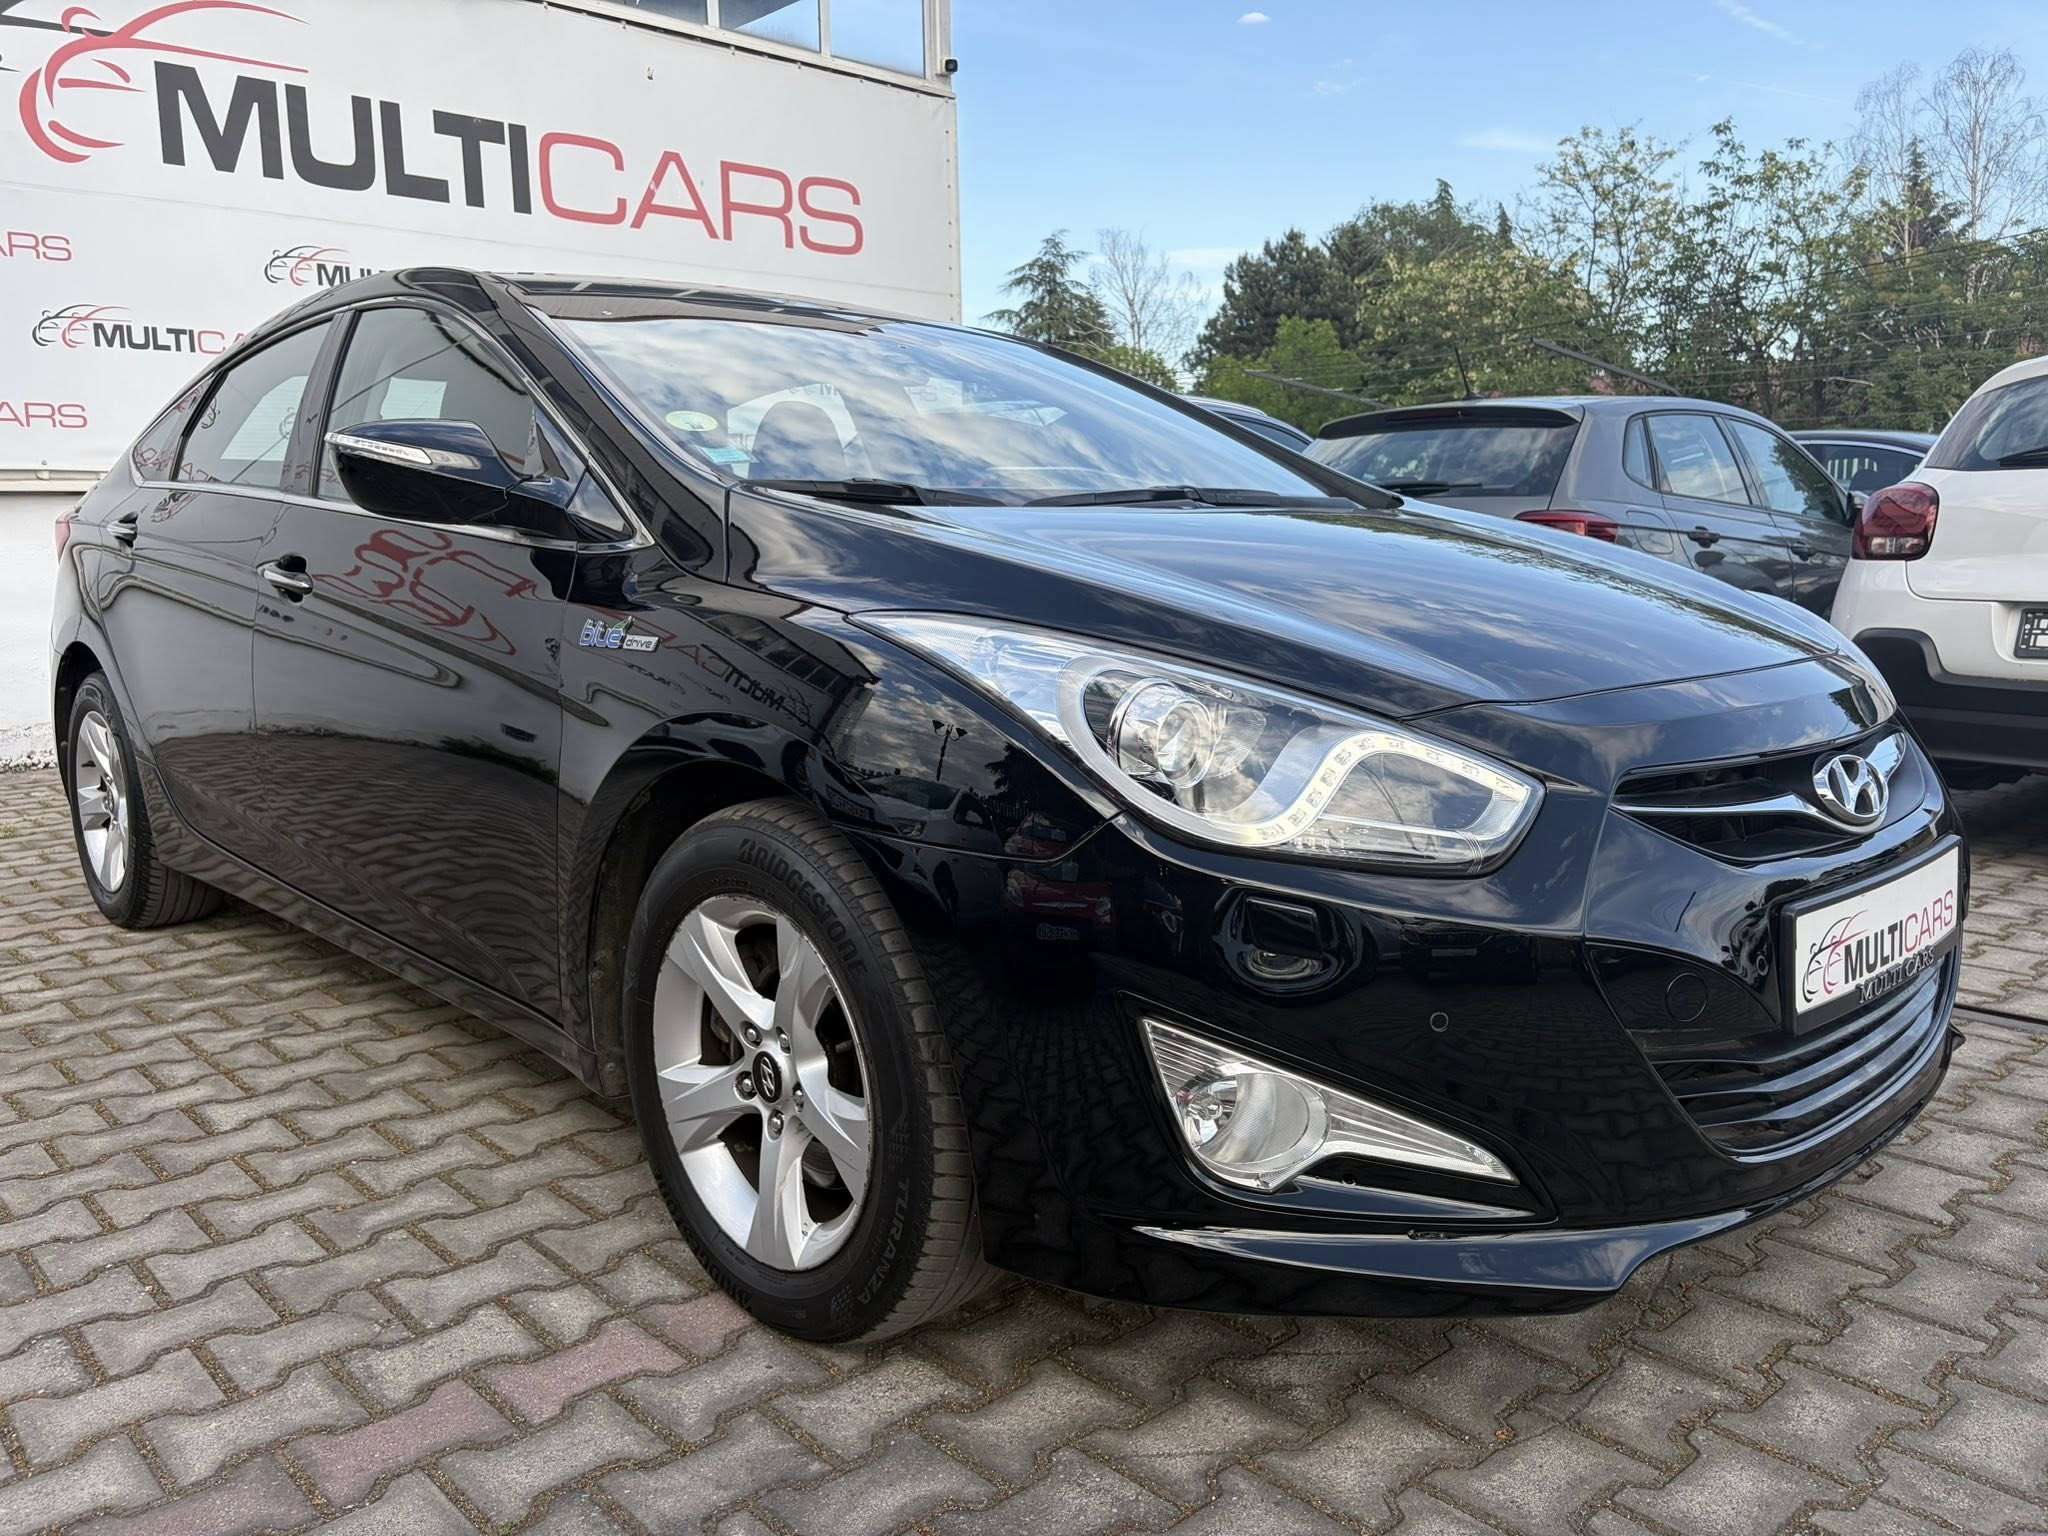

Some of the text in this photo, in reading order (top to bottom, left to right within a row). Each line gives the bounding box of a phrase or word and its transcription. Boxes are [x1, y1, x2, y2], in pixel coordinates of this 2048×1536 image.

[154, 60, 864, 256] MULTICARS
[1844, 889, 1953, 985] MULTICARS
[1859, 947, 1935, 1003] MULTI CARS
